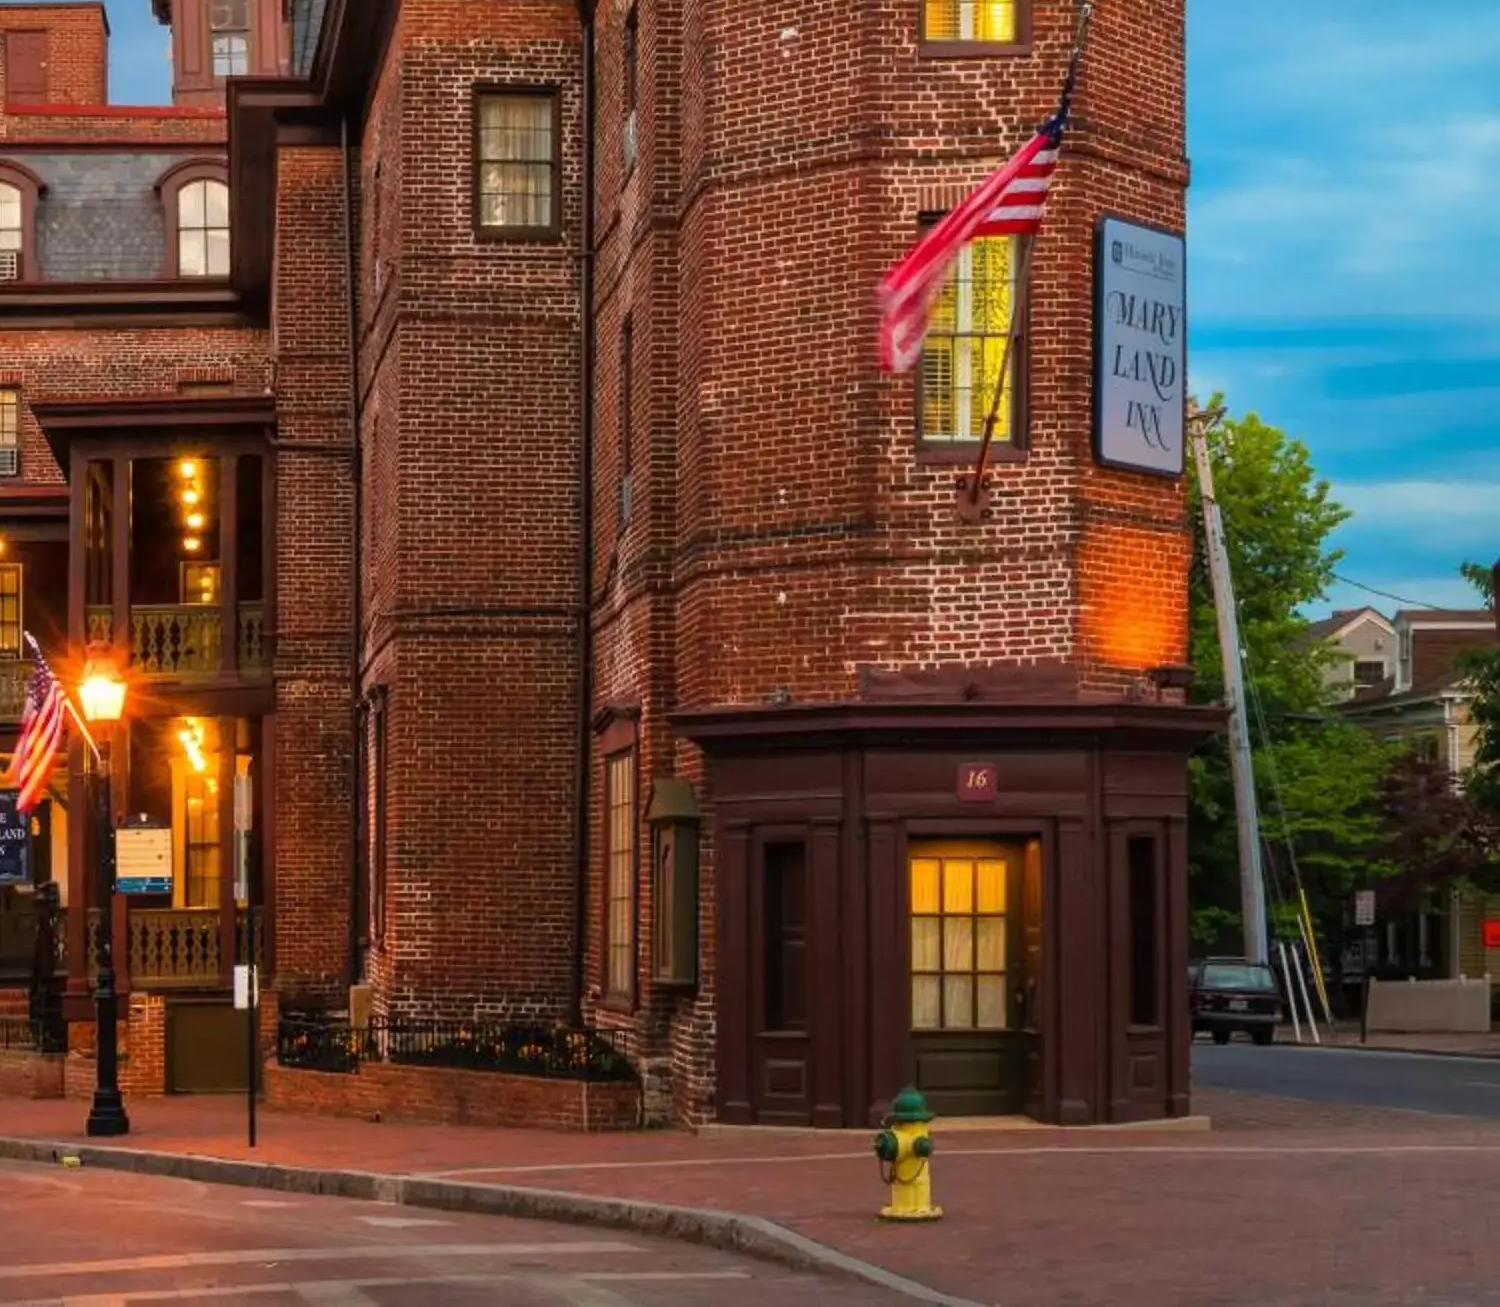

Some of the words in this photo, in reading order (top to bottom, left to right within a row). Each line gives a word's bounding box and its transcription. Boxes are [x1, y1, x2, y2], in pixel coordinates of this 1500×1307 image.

[1106, 291, 1181, 346] MARY
[1112, 344, 1176, 401] LAND
[1125, 400, 1171, 451] INN
[966, 769, 989, 789] 16
